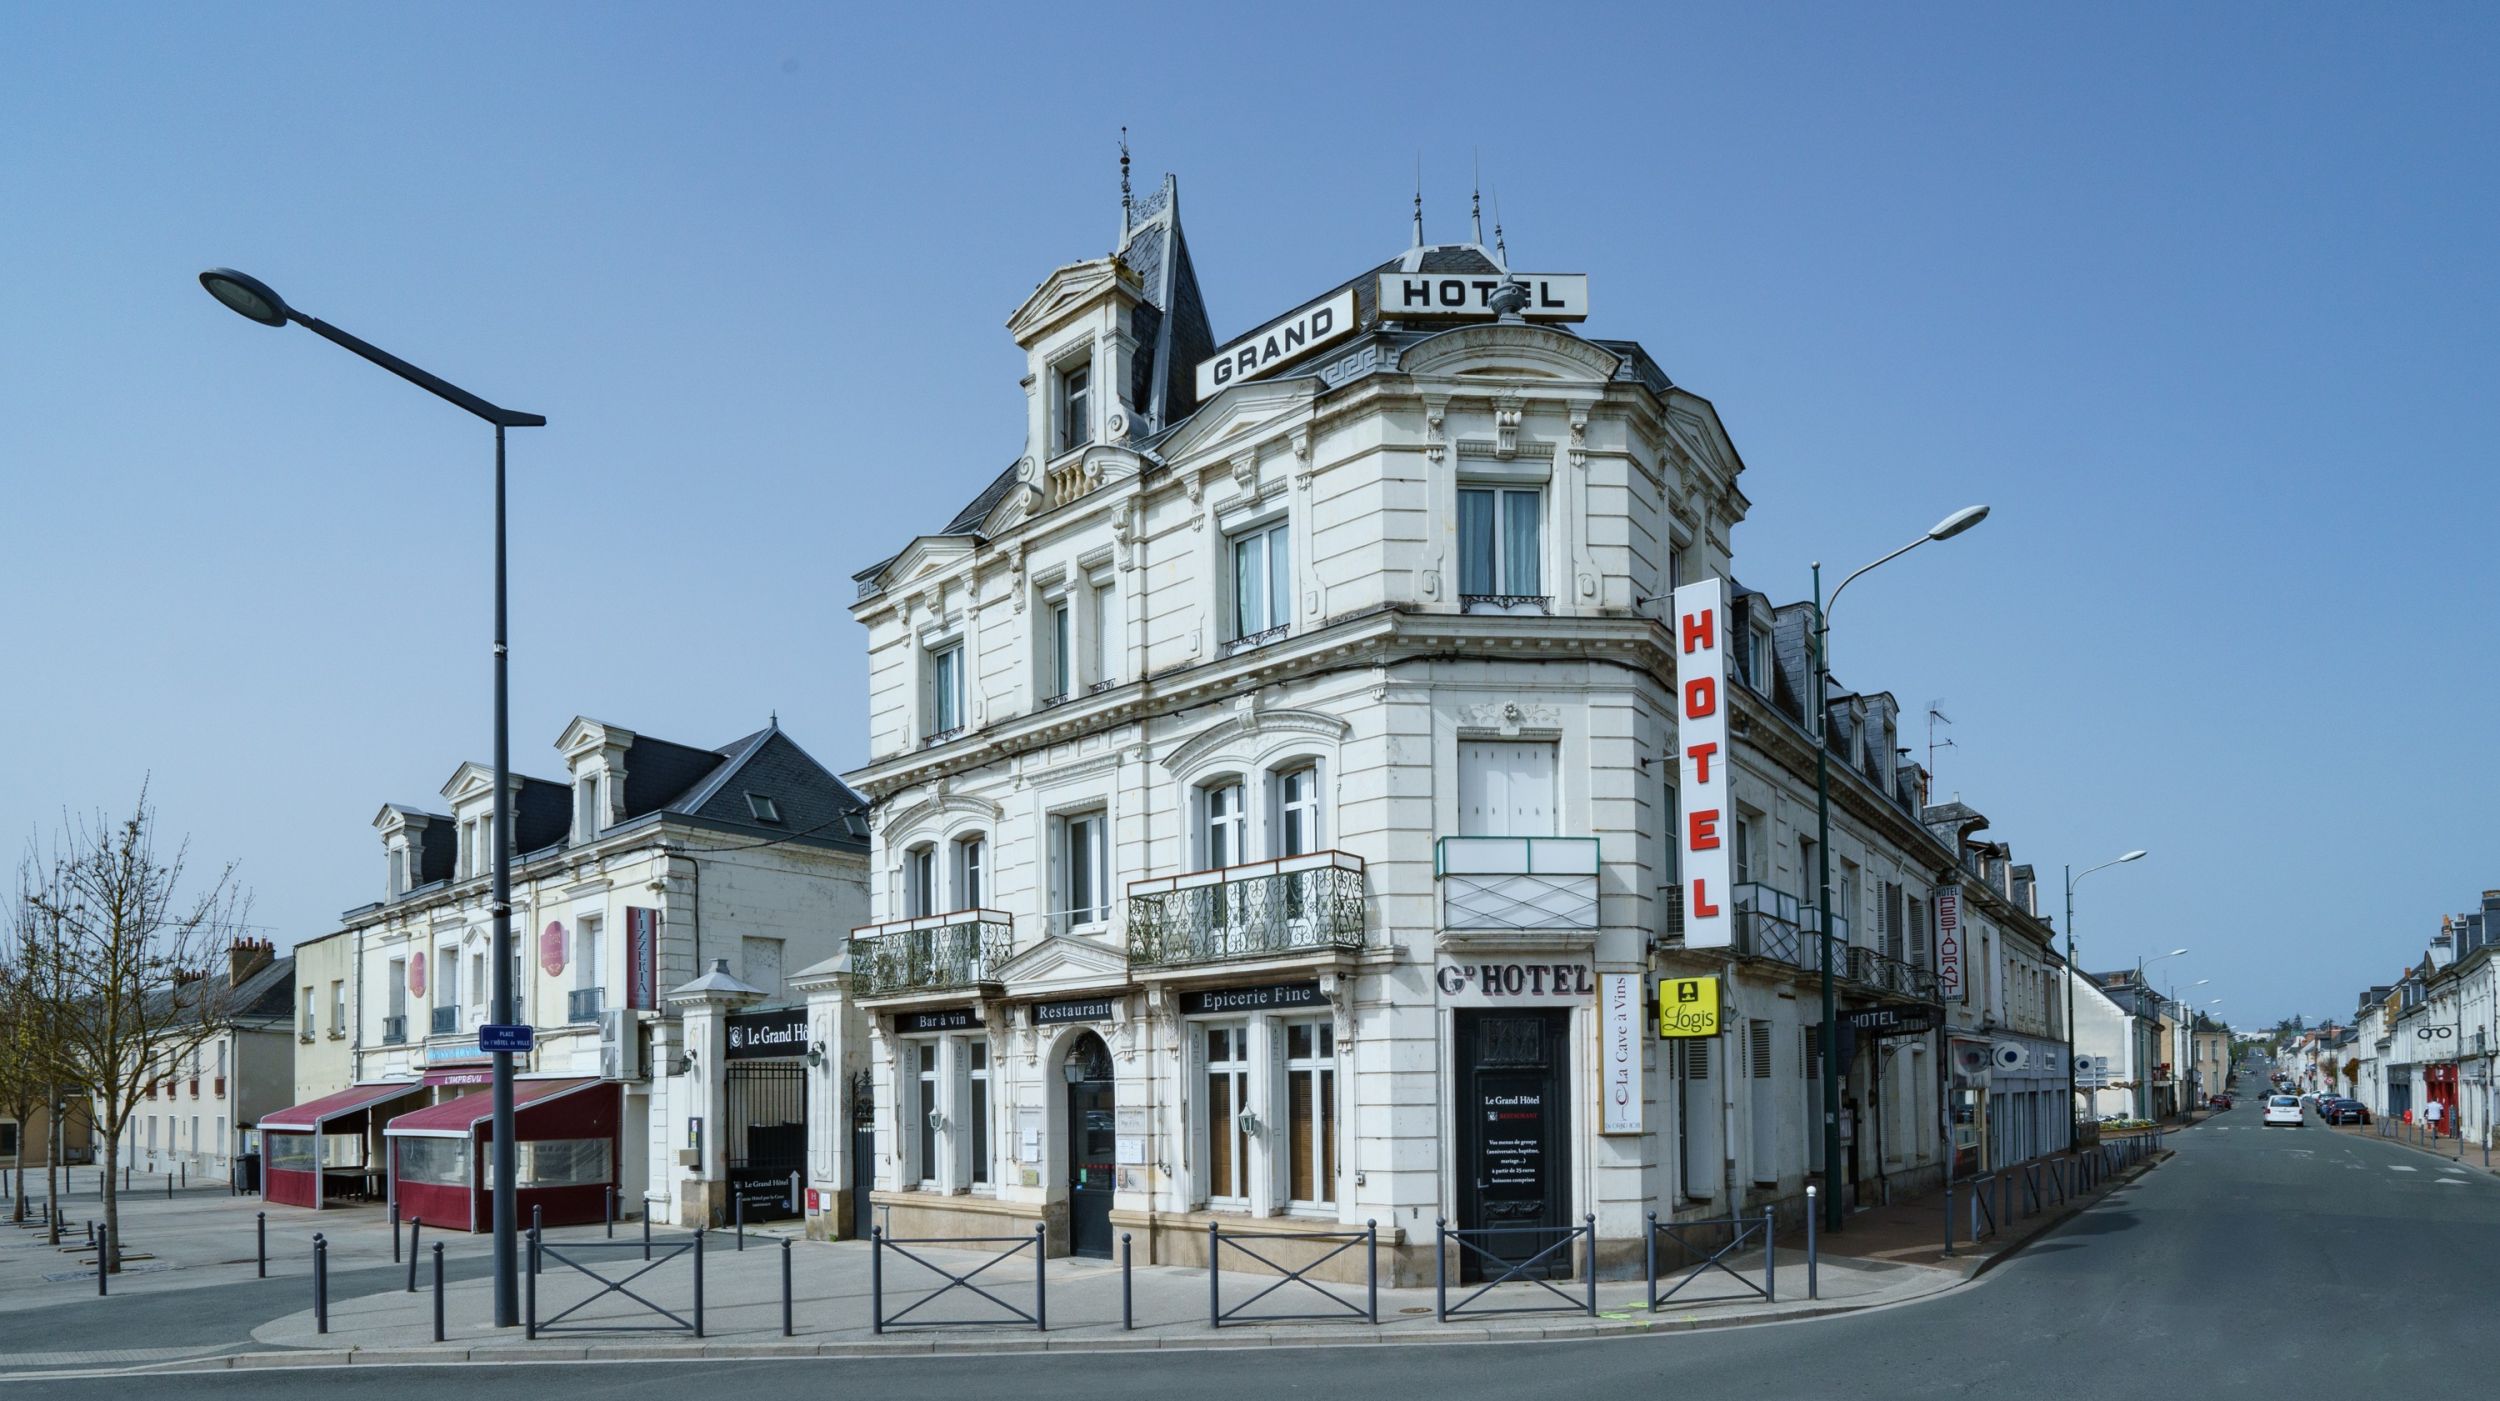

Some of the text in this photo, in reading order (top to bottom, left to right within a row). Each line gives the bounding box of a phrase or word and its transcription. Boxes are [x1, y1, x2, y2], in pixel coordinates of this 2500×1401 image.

[1214, 307, 1333, 386] GRAND
[1682, 608, 1721, 918] HOTEL
[1936, 886, 1959, 898] HOTEL
[637, 909, 648, 993] PIZZERIA
[1940, 897, 1958, 994] RESTAURANT
[1481, 964, 1594, 996] HOTEL
[1203, 987, 1311, 1010] Epicerie Fine
[1614, 977, 1626, 1011] Vins
[919, 1012, 966, 1028] Bar à vin
[1039, 1002, 1110, 1018] Restaurant
[1614, 1013, 1627, 1021] à
[1662, 1003, 1714, 1033] Logis
[747, 1027, 760, 1045] Le
[761, 1023, 792, 1044] Grand
[1616, 1026, 1628, 1063] Cave
[1485, 1095, 1540, 1105] Le Grand Hôtel
[753, 1179, 772, 1188] Grand
